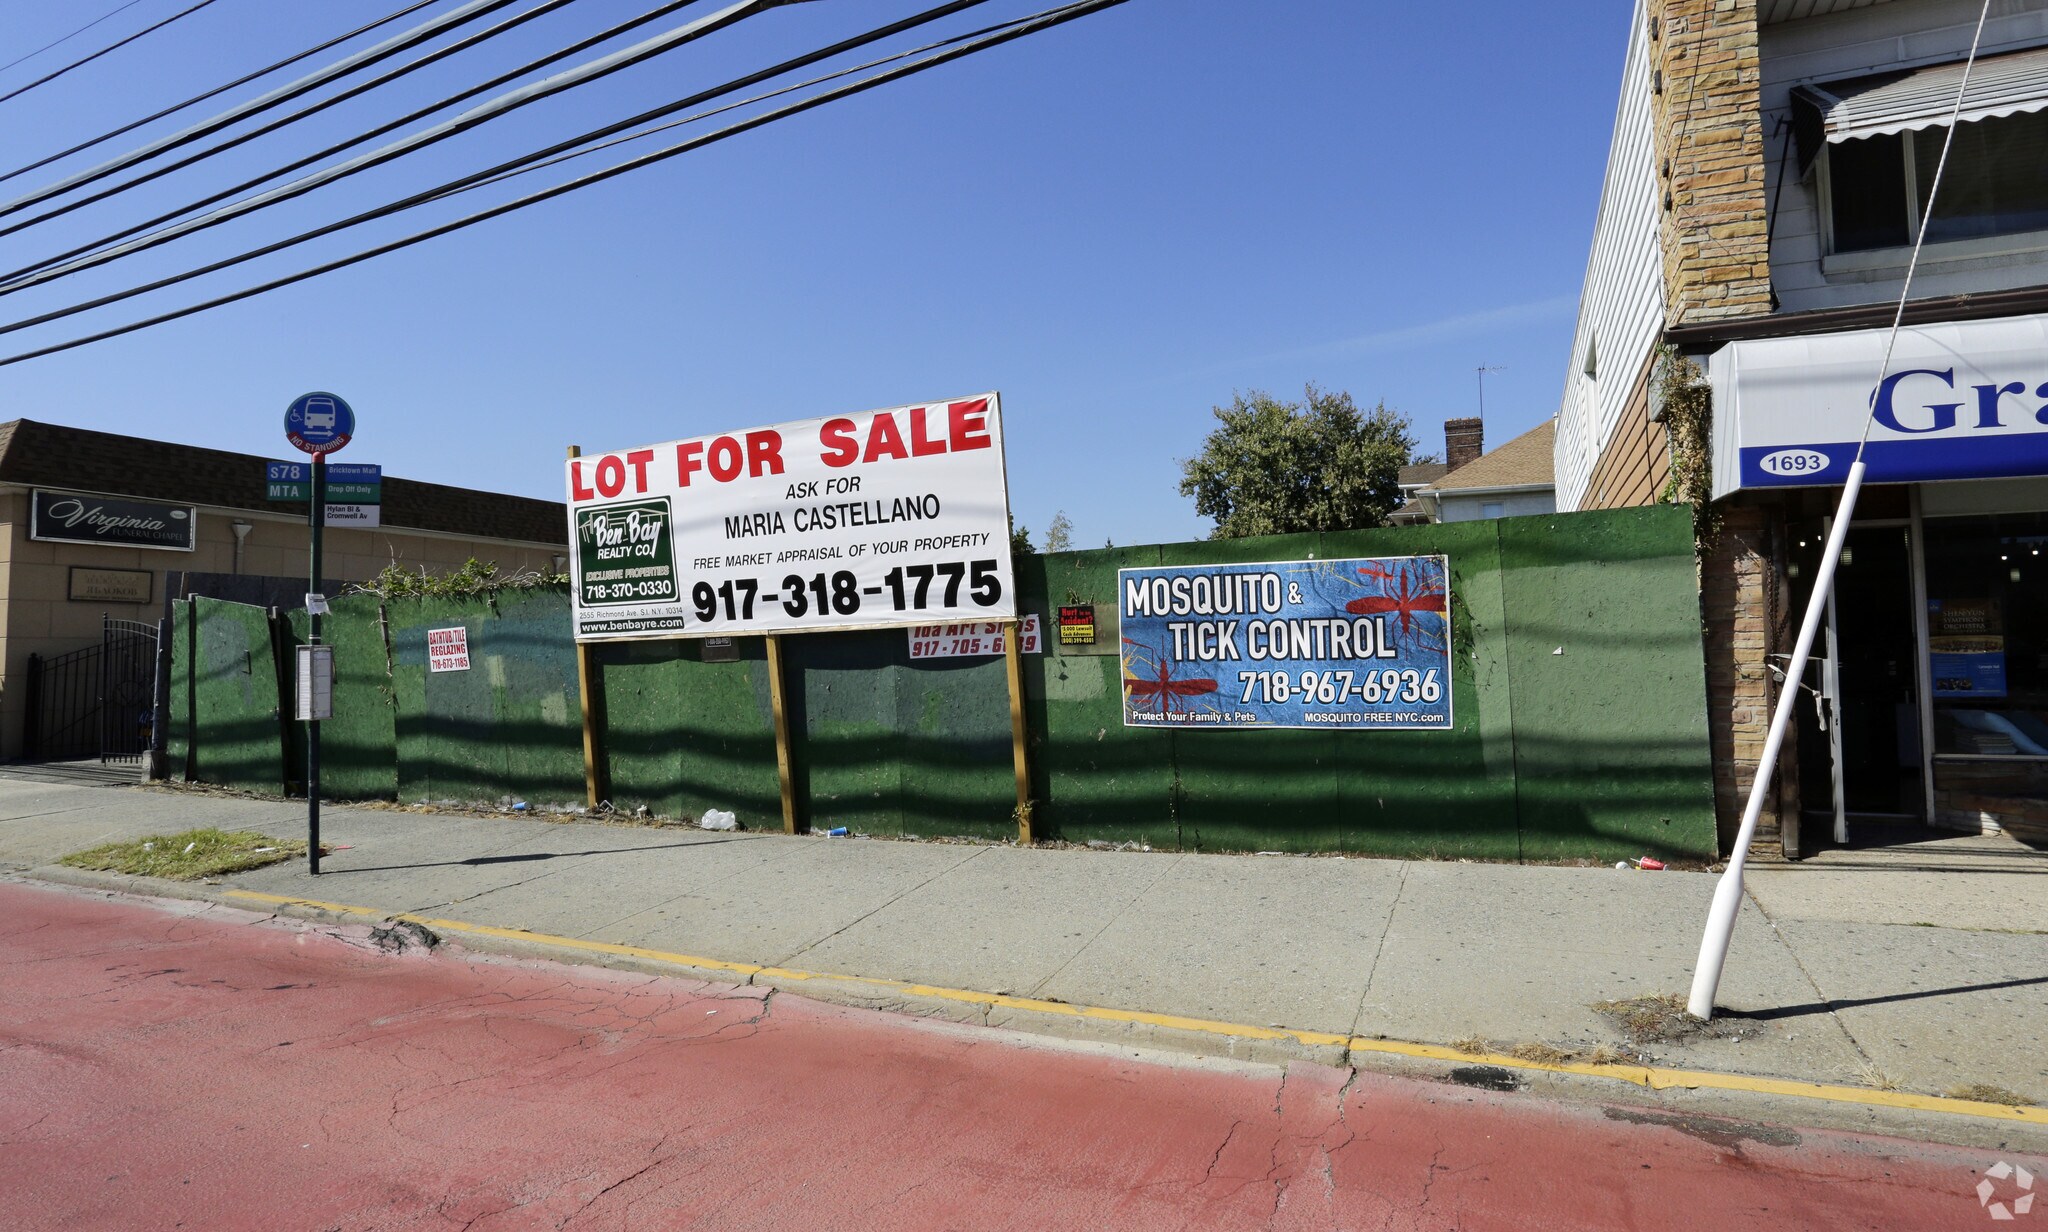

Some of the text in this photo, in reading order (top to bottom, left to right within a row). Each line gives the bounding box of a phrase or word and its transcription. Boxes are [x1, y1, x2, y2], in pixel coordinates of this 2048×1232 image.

[290, 435, 344, 452] NO STANDING
[571, 398, 992, 501] LOT FOR SALE
[329, 466, 361, 474] Bricktown
[1768, 455, 1821, 471] 1693
[270, 465, 300, 479] S78
[269, 485, 299, 497] MTA
[328, 485, 344, 494] Drop
[356, 486, 371, 494] Only
[785, 476, 861, 500] ASK FOR
[48, 499, 166, 534] Virginia
[327, 505, 346, 514] Hylan
[724, 493, 941, 539] MARIA CASTELLANO
[112, 528, 183, 541] FUNERAL CHAPEL
[593, 511, 661, 559] Ben Bay
[597, 544, 653, 560] REALTY CO.
[693, 532, 991, 570] FREE MARKET APPRAISAL OF YOUR PROPERTY
[585, 565, 670, 582] EXCLUSIVE PROPERTIES
[586, 580, 672, 599] 718-370-0330
[691, 559, 1002, 623] 917-318-1775
[1126, 573, 1302, 617] MOSQUITO &
[580, 611, 594, 619] 2555
[597, 609, 624, 618] Richmond
[626, 609, 638, 617] Ave.
[665, 606, 683, 615] 10314
[1061, 607, 1077, 616] Hurt
[582, 618, 683, 632] www.benbayre.com
[945, 623, 977, 636] Art
[985, 619, 1036, 634] Sis
[1060, 615, 1094, 625] Accident?
[1169, 617, 1396, 661] TICK CONTROL
[431, 643, 466, 656] REGLAZING
[1239, 669, 1441, 704] 718-967-6936
[1133, 711, 1256, 723] Protect Your Family & Pets
[1304, 713, 1444, 723] MOSQUITO FREE NYC.com
